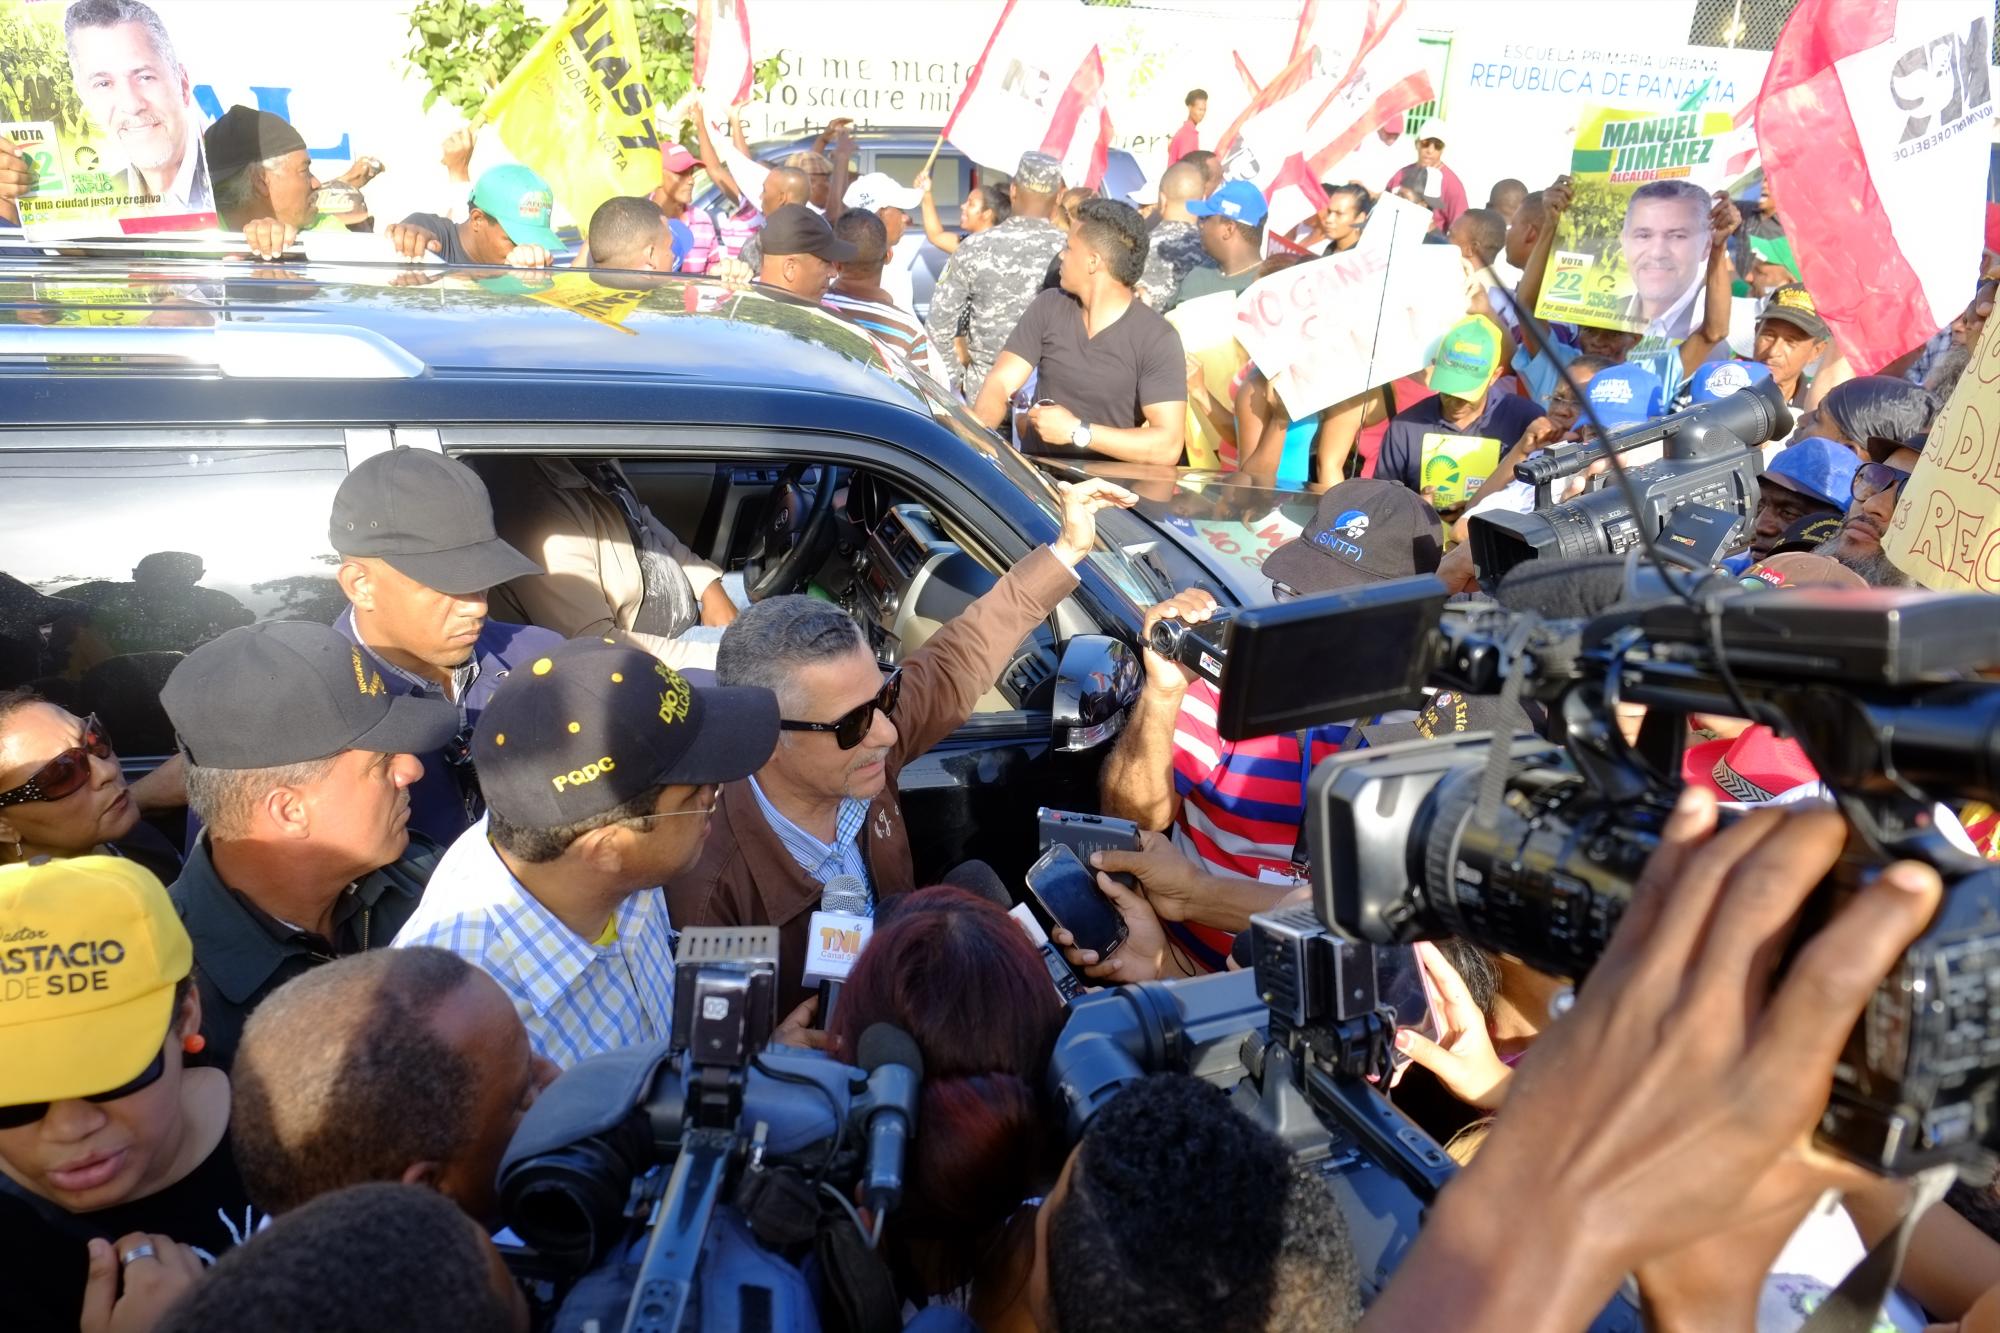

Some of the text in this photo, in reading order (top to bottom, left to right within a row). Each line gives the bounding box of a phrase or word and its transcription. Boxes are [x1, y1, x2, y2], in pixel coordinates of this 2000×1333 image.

[569, 0, 653, 117] LIAS
[1504, 44, 1720, 73] ESCUELA PRIMARIA URBANA
[1470, 63, 1593, 95] REPUBLICA
[1601, 71, 1629, 97] DE
[11, 129, 44, 142] VOTA
[1601, 113, 1698, 148] MANUEL
[1613, 138, 1715, 173] JIMÉNEZ
[19, 200, 32, 211] Por
[35, 200, 53, 210] una
[56, 197, 88, 209] ciudad
[90, 195, 114, 208] justa
[123, 194, 161, 205] creativa
[1561, 256, 1584, 267] VOTA
[1553, 271, 1583, 292] 22
[1541, 302, 1555, 311] Por
[1569, 305, 1593, 317] ciudad
[1467, 478, 1486, 486] VOT
[1314, 530, 1363, 562] (SNTP)
[1760, 570, 1781, 585] LOVE
[552, 756, 616, 793] PQDC
[46, 970, 110, 996] SDE
